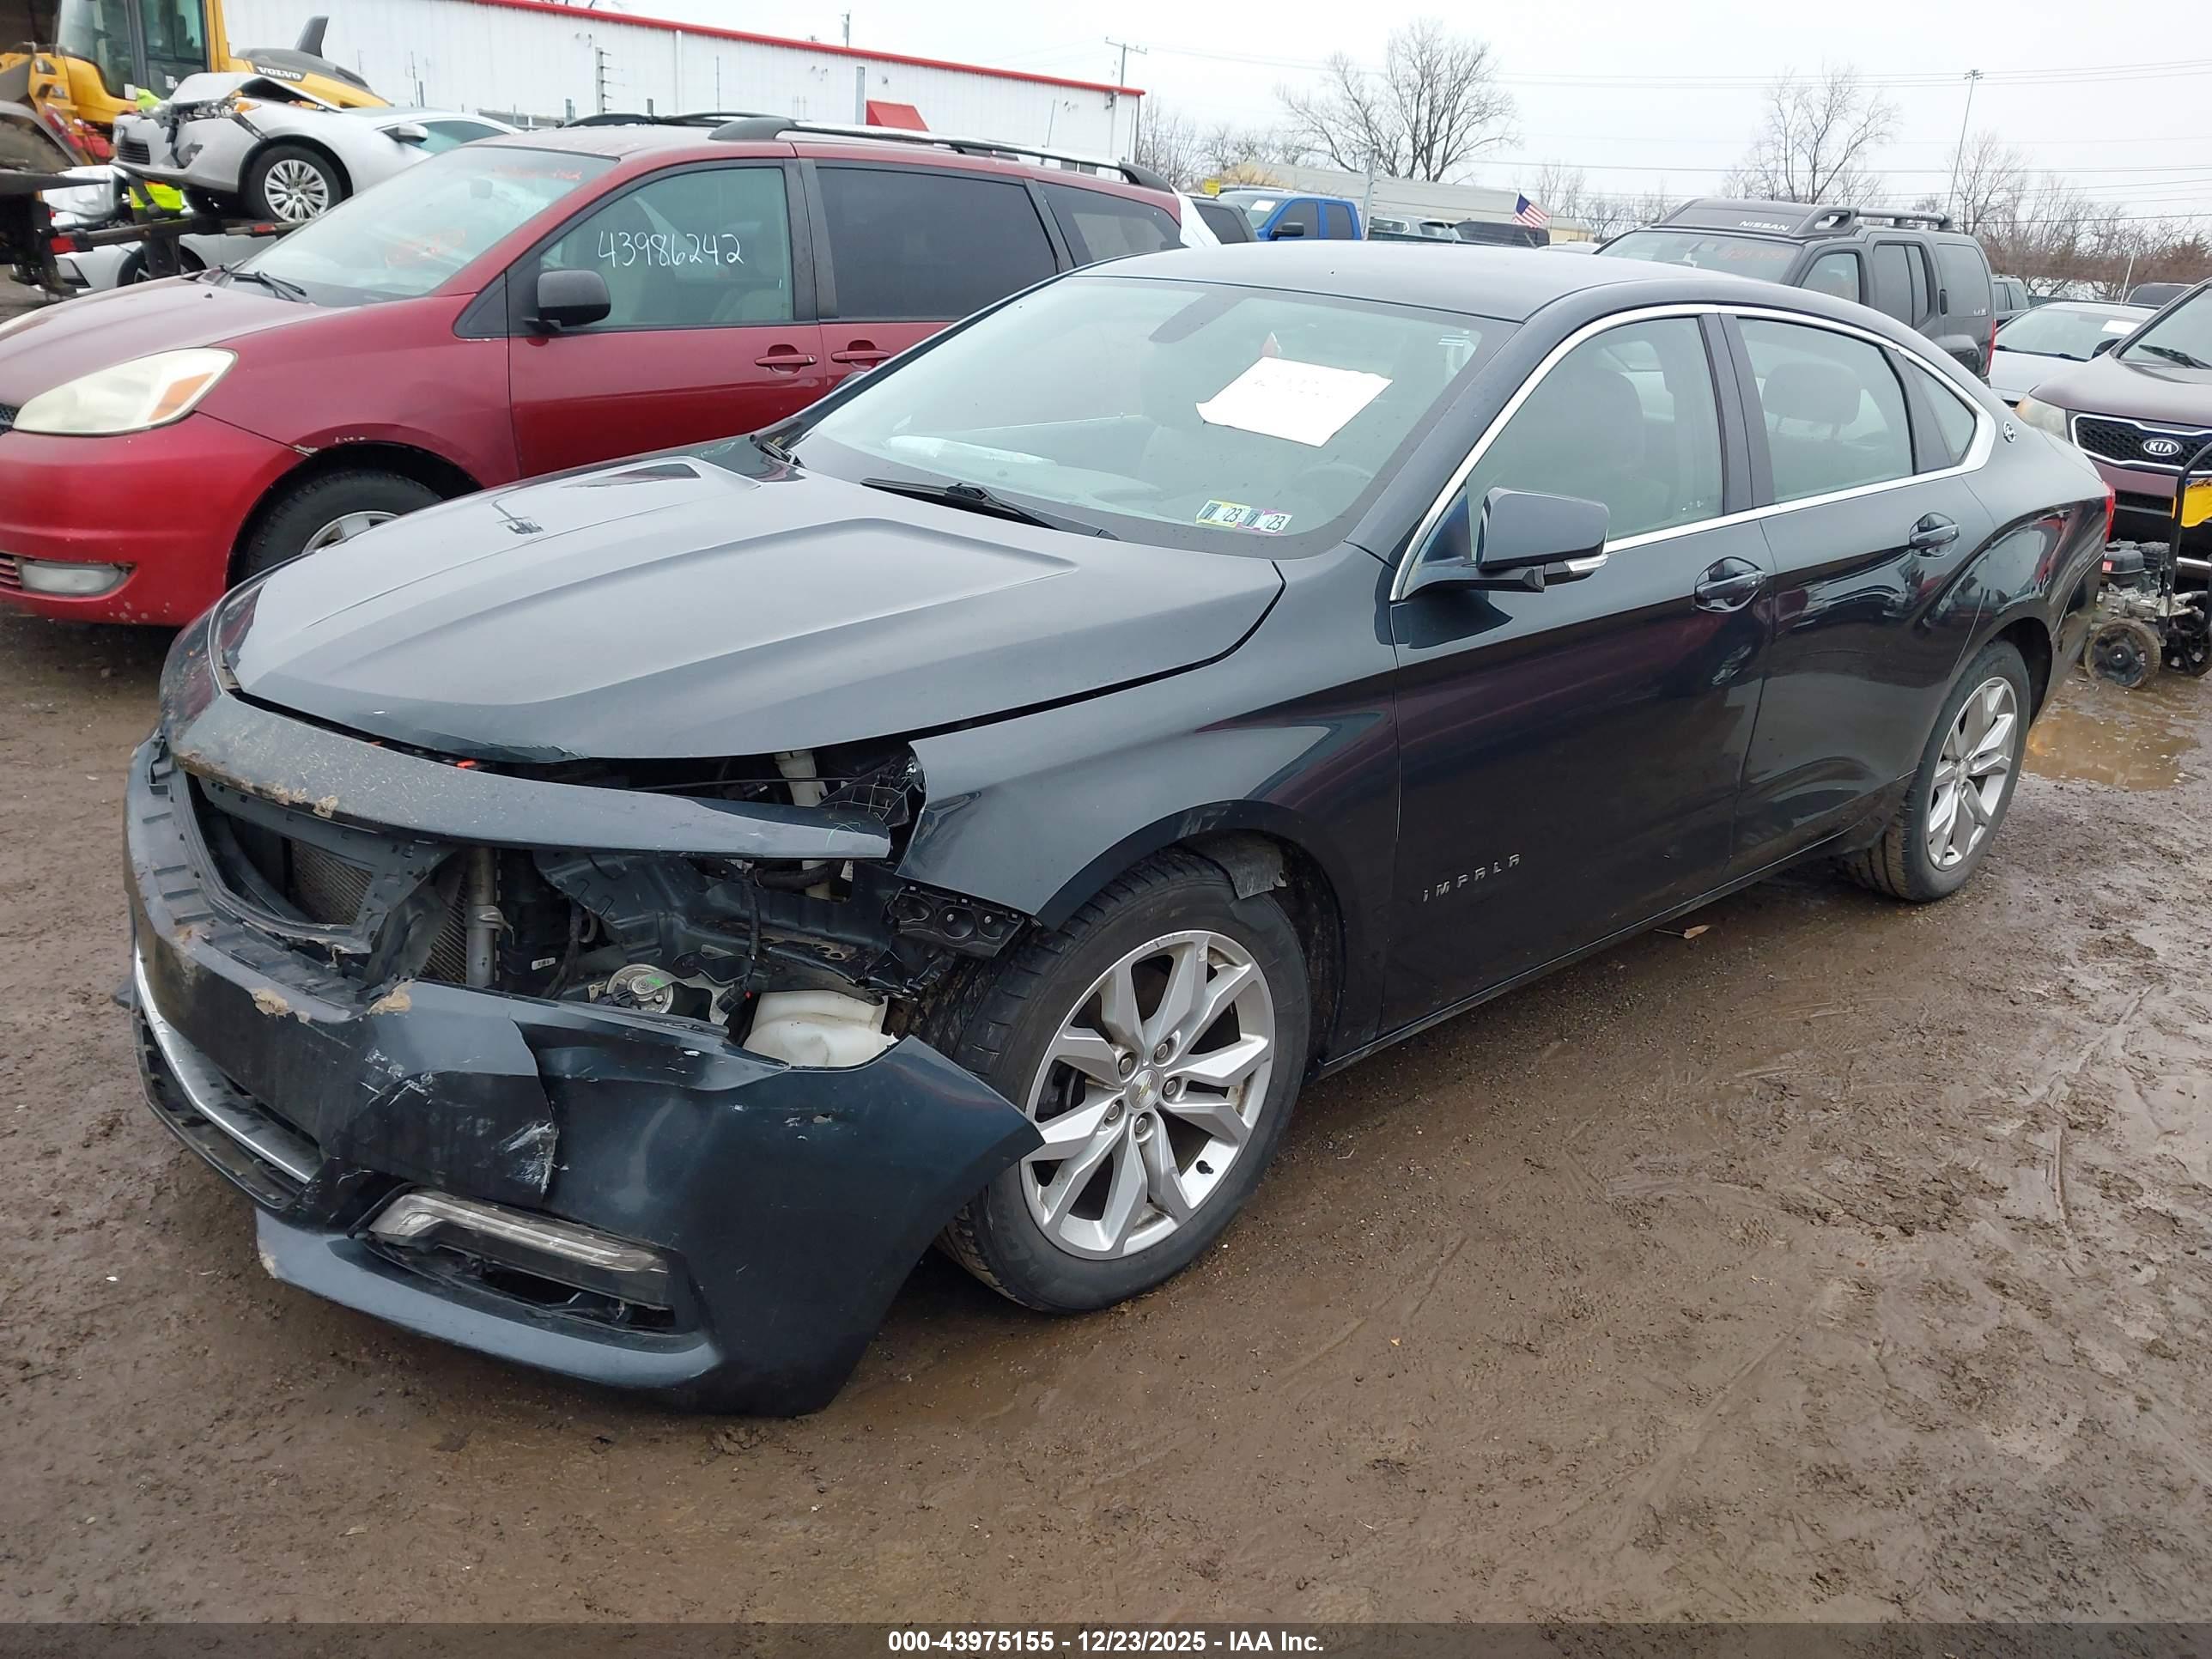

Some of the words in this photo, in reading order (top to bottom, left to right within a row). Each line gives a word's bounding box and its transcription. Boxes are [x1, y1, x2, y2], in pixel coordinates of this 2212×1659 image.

[257, 65, 302, 80] VOLVO
[1738, 220, 1790, 232] NISSAN
[598, 230, 744, 268] 43986242
[2148, 441, 2172, 453] KIA
[1223, 507, 1243, 523] 23
[1266, 514, 1286, 531] 23
